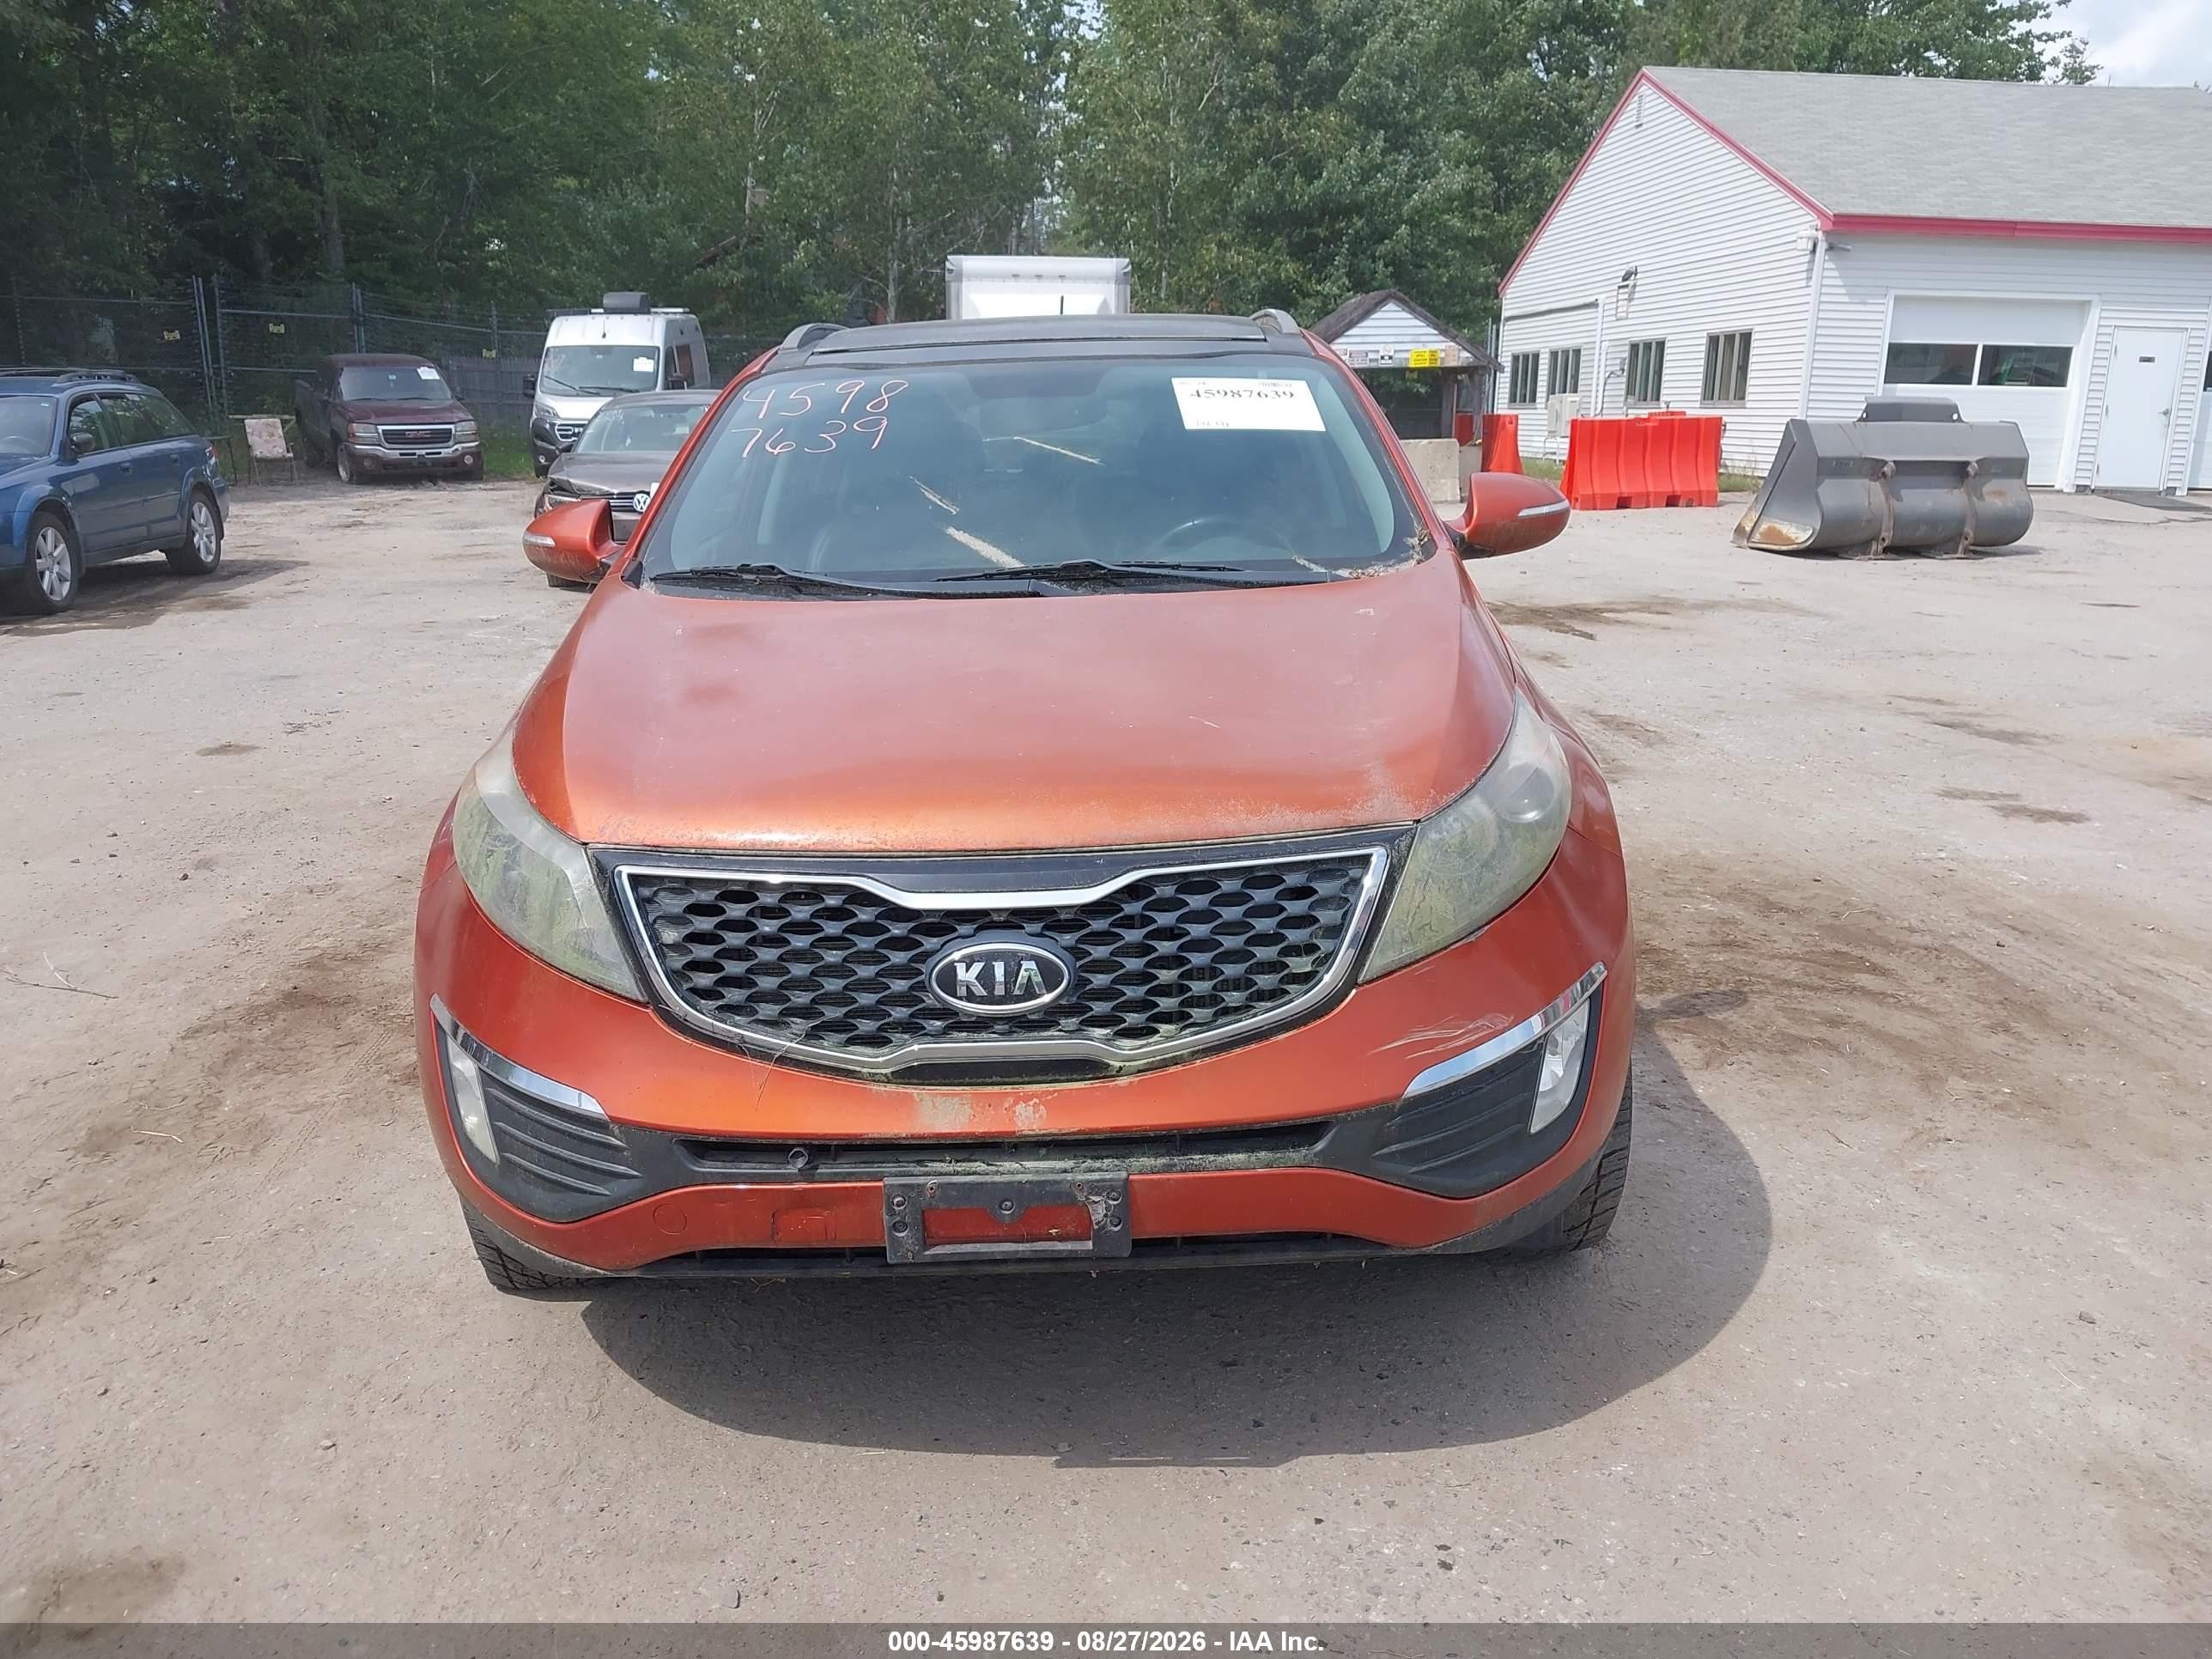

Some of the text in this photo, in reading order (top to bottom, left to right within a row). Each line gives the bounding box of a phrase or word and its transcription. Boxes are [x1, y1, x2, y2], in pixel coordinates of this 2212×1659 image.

[742, 380, 908, 419] 4598
[1189, 388, 1295, 399] 45987639
[731, 416, 888, 459] 7639
[953, 960, 1047, 997] KIA
